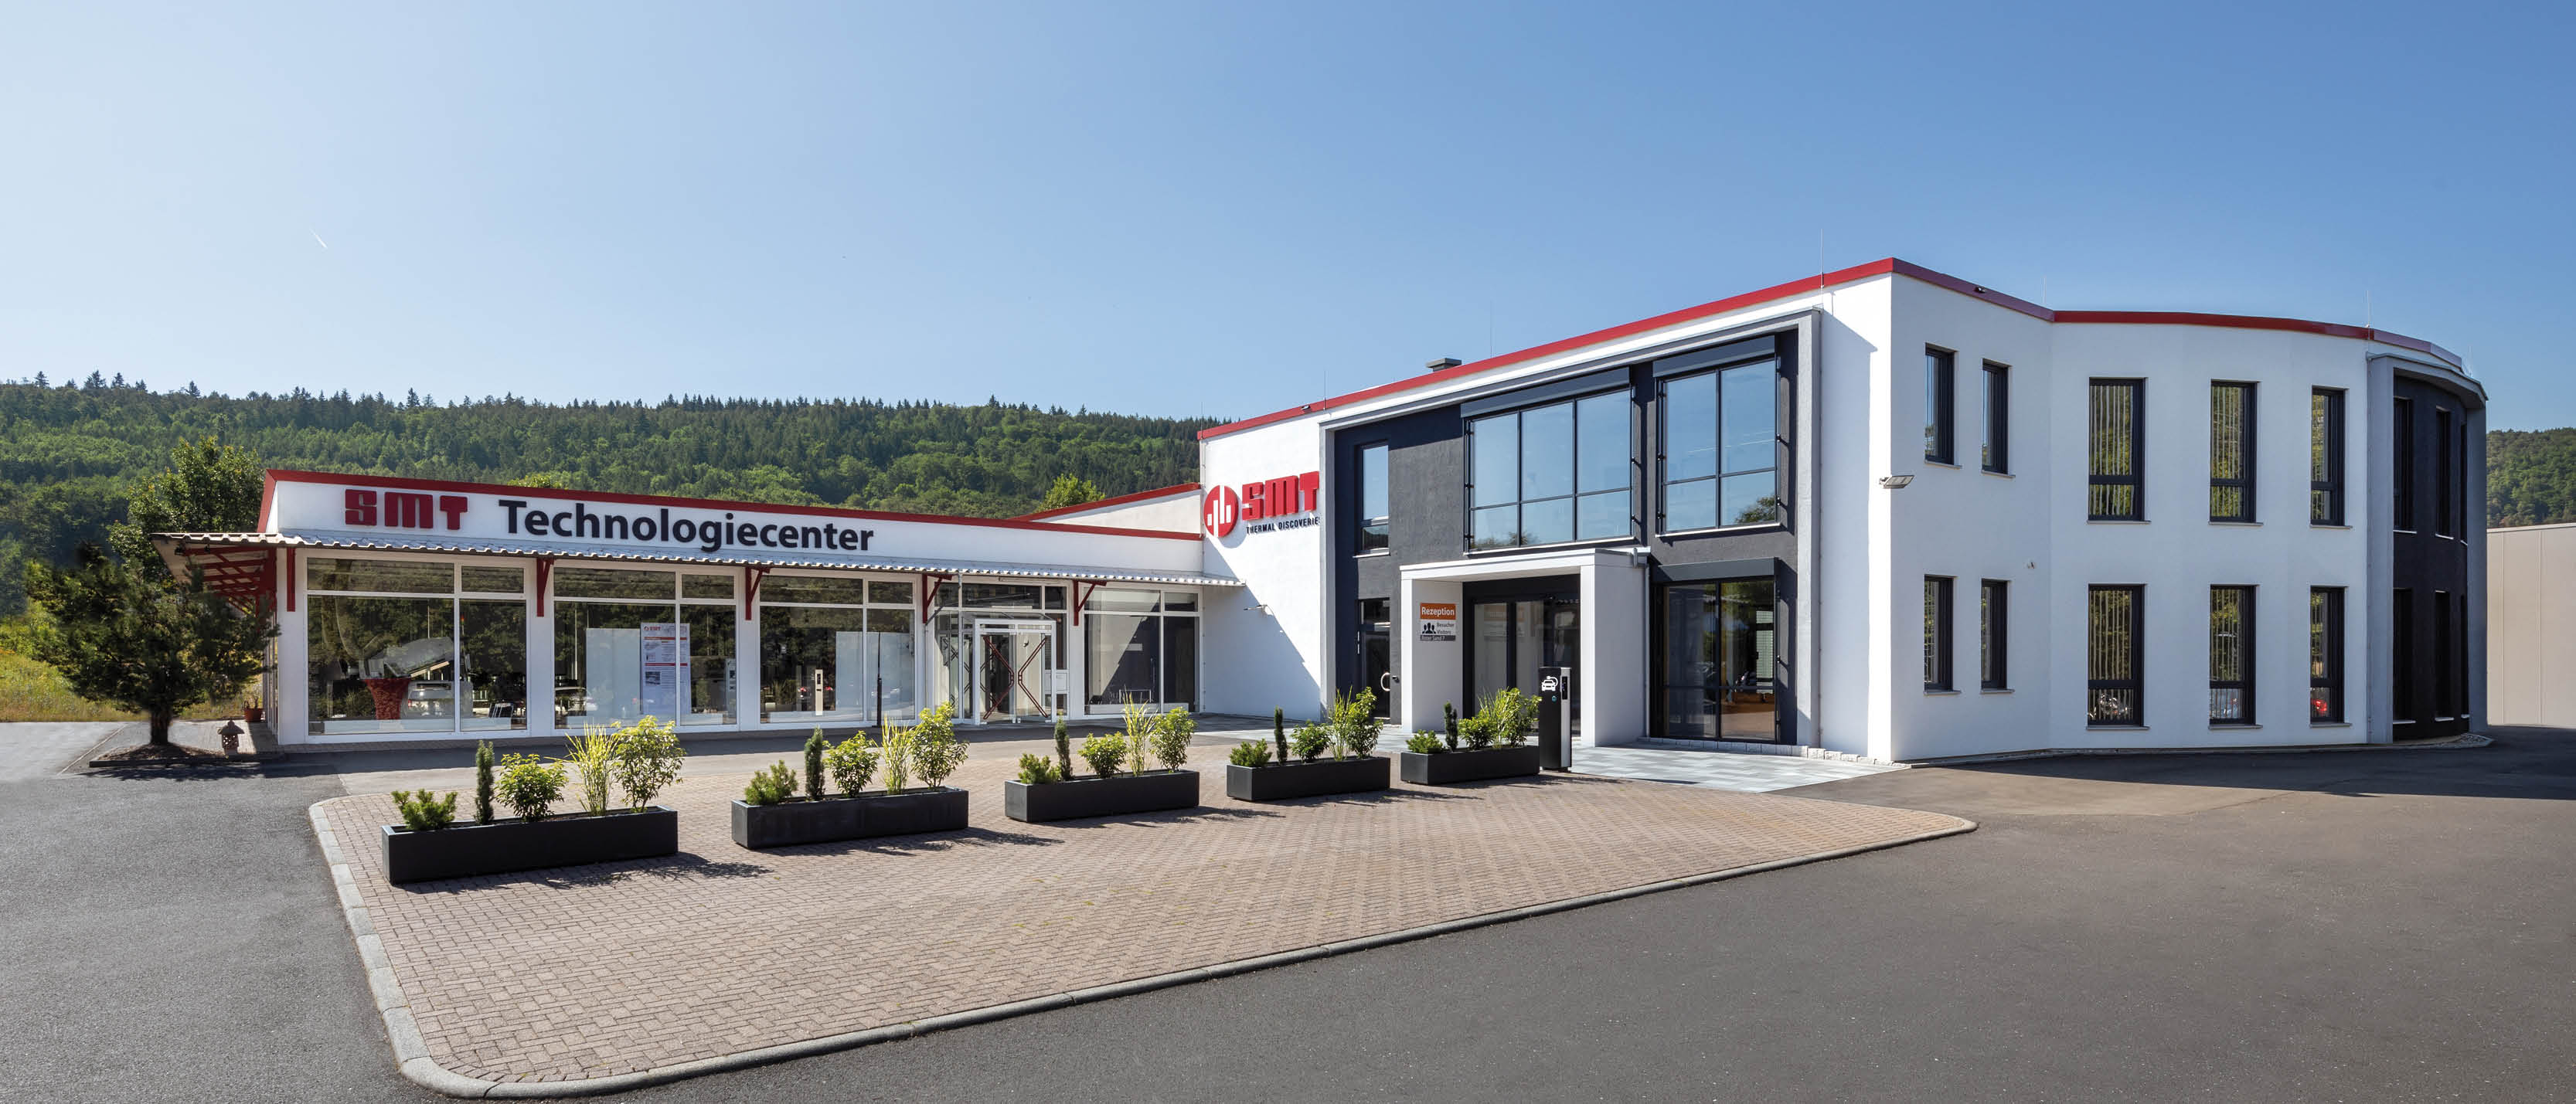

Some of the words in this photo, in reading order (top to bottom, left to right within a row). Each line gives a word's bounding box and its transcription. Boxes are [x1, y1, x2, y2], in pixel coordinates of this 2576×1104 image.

[1241, 470, 1319, 521] SMT
[345, 488, 468, 531] SMT
[499, 499, 874, 552] Technologiecenter
[1246, 523, 1276, 535] THERMAL
[1421, 606, 1455, 617] Rezeption
